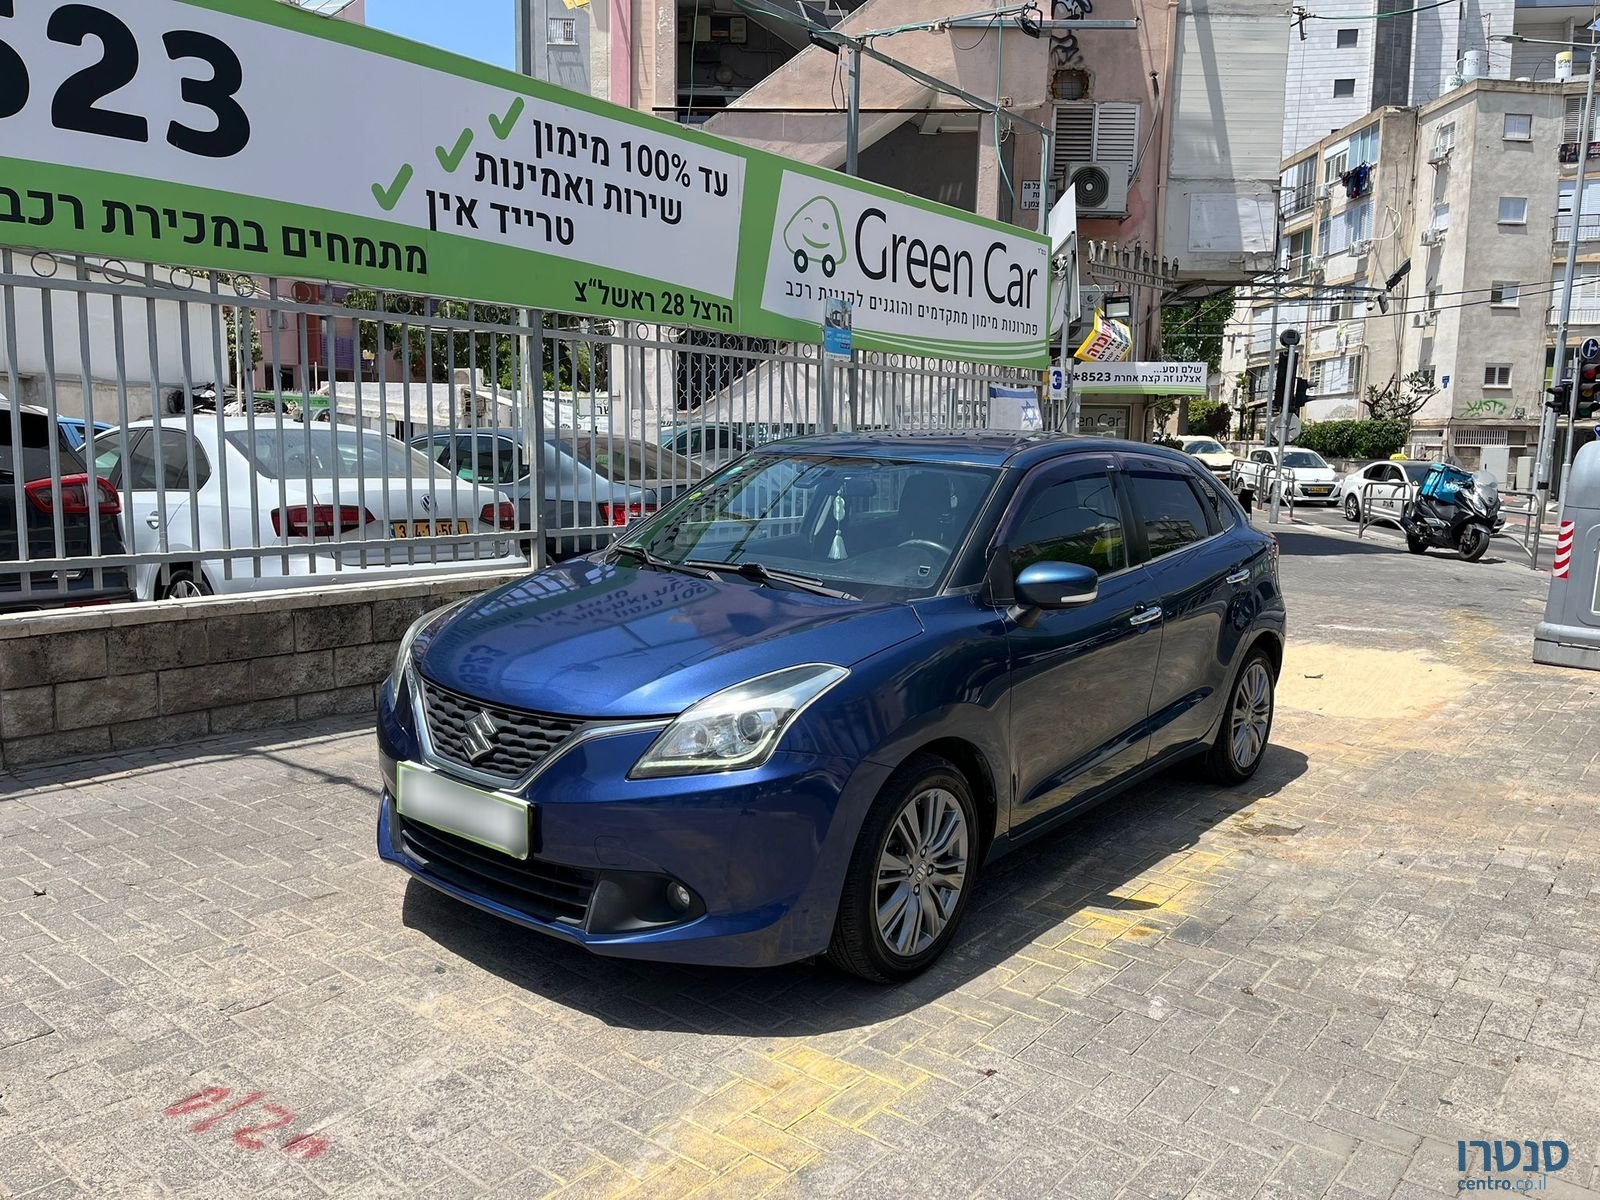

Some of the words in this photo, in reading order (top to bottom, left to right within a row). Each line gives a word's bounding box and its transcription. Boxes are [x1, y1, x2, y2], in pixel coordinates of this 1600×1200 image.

[532, 119, 610, 167] מימון
[620, 140, 691, 187] 100%
[474, 152, 594, 207] ואמינות
[698, 165, 728, 197] עד
[0, 187, 85, 230] רכב
[426, 189, 478, 232] אין
[603, 182, 682, 225] שירות
[101, 200, 268, 253] במכירת
[490, 203, 575, 246] טרייד
[282, 226, 428, 275] מתמחים
[855, 208, 974, 298] Green
[983, 241, 1038, 310] Car
[661, 291, 684, 316] 28
[785, 280, 812, 299] רכב
[690, 295, 733, 324] הרצל
[870, 296, 912, 316] והוגנים
[918, 304, 968, 326] מתקדמים
[972, 313, 998, 330] מימון
[1001, 318, 1038, 336] פתרונות
[1114, 374, 1139, 382] אחרת
[1141, 374, 1160, 383] קצת
[1163, 374, 1173, 382] זה
[1176, 374, 1201, 383] אצלנו
[1181, 365, 1202, 374] שלם
